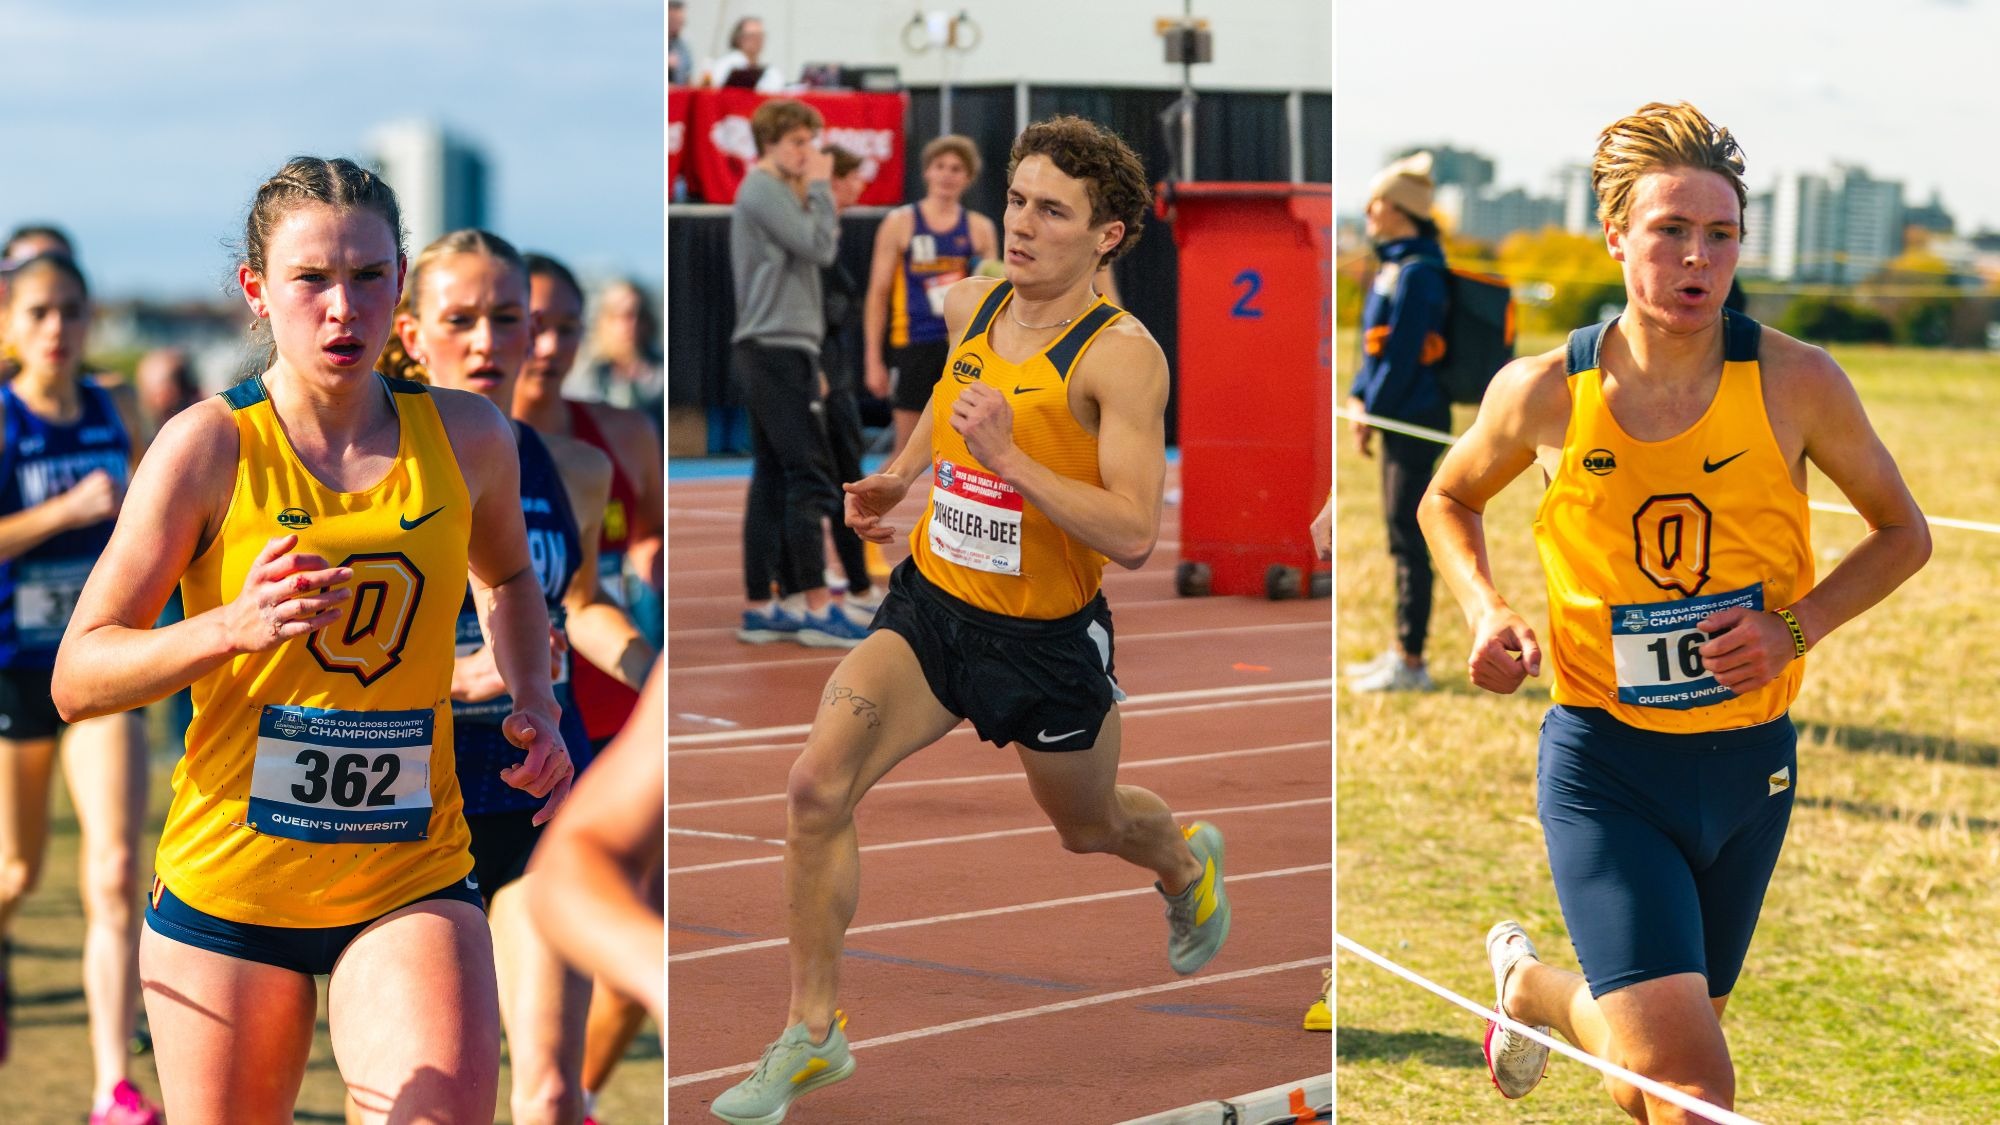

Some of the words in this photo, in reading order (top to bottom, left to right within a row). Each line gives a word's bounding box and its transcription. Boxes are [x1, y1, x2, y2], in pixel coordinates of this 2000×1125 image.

[1231, 269, 1264, 317] 2
[953, 360, 981, 380] OUA
[1583, 457, 1616, 469] OUA
[962, 482, 1002, 499] CHAMPIONSHIPS
[977, 475, 993, 488] TRACK
[998, 482, 1014, 493] FIELD
[277, 513, 313, 525] OUA
[933, 500, 1017, 545] WHEELER-DEE
[1632, 493, 1712, 597] Q
[1649, 609, 1672, 617] 2025
[1672, 607, 1690, 615] OUA
[1690, 602, 1718, 612] CROSS
[1717, 594, 1753, 607] COUNTRY
[306, 552, 425, 687] Q
[1647, 627, 1732, 682] 16
[1638, 692, 1689, 705] QUEEN'S
[1690, 685, 1731, 699] UNIVER
[309, 727, 423, 739] CHAMPIONSHIPS
[311, 717, 336, 727] 2025
[337, 720, 358, 729] OUA
[359, 721, 388, 729] CROSS
[389, 719, 424, 728] COUNTRY
[291, 749, 401, 808] 362
[271, 813, 332, 830] QUEEN'S
[335, 820, 408, 832] UNIVERSITY
